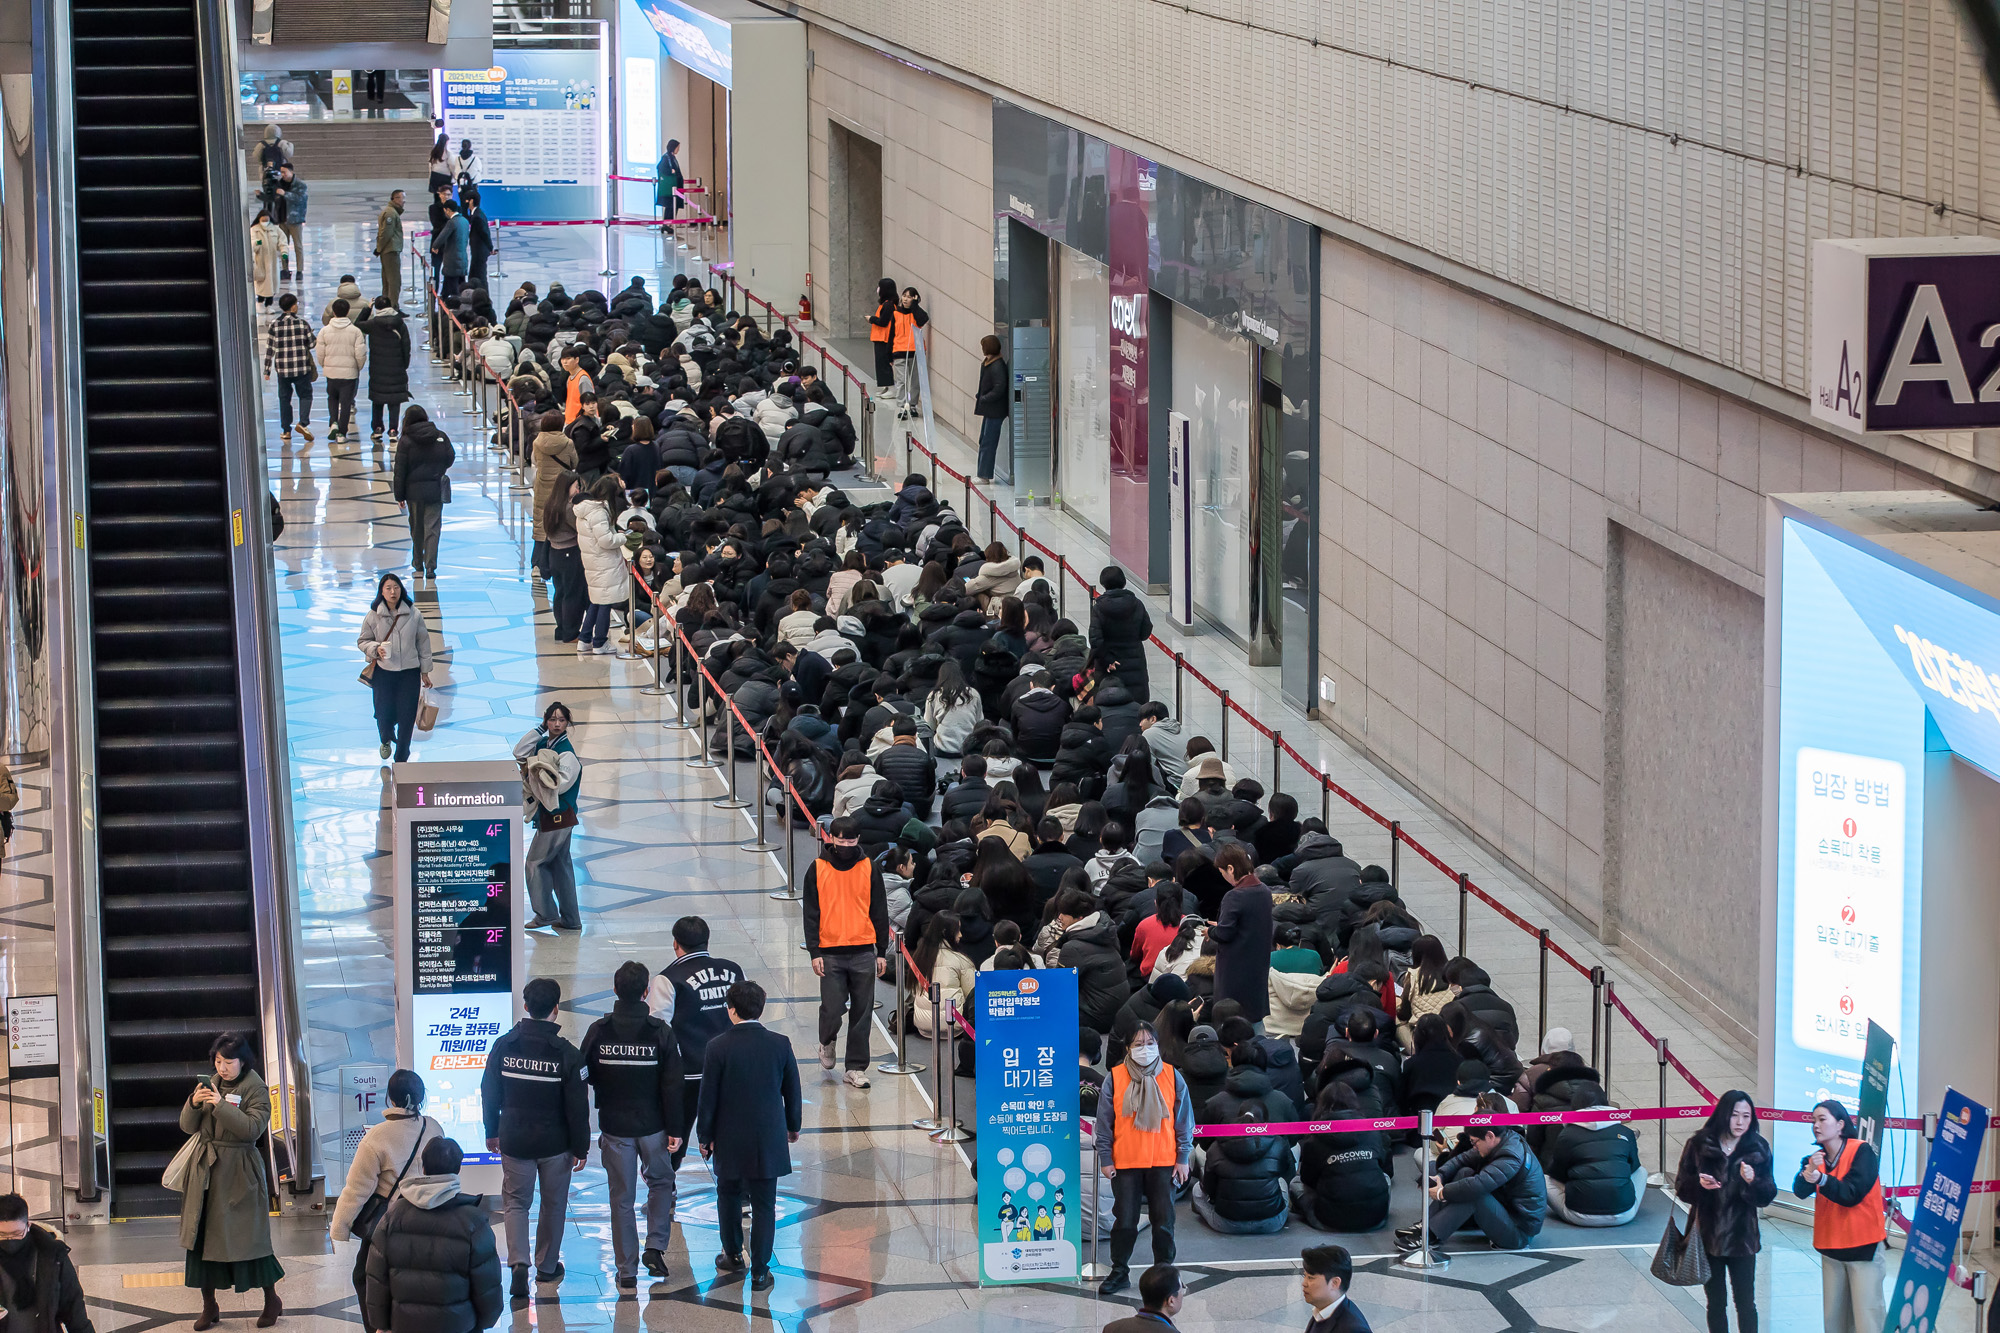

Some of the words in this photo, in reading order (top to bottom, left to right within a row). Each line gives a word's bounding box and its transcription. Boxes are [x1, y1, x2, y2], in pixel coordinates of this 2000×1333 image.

[1111, 294, 1137, 339] coex
[1819, 385, 1834, 409] Hall
[1835, 340, 1861, 420] A2
[1812, 770, 1847, 800] 입장
[1854, 778, 1889, 808] 방법
[434, 792, 504, 806] information
[486, 824, 503, 837] 4F
[1818, 838, 1853, 858] 손목띠
[1858, 844, 1881, 864] 착용
[486, 884, 504, 897] 3F
[1842, 906, 1855, 925] 2
[486, 930, 504, 943] 2F
[1817, 925, 1840, 945] 입장
[1844, 930, 1879, 953] 대기줄
[686, 968, 736, 991] EULJI
[988, 997, 1040, 1008] 대학입학정보
[1841, 996, 1854, 1015] 3
[988, 1007, 1015, 1017] 박람회
[426, 1024, 463, 1036] 고성능
[465, 1022, 500, 1036] 컴퓨팅
[1815, 1015, 1850, 1037] 전시장
[440, 1039, 487, 1052] 지원사업
[599, 1044, 656, 1057] SECURITY
[503, 1056, 560, 1073] SECURITY
[354, 1076, 376, 1084] South
[1004, 1068, 1054, 1088] 대기줄
[354, 1093, 376, 1112] 1F
[1000, 1101, 1026, 1111] 손목띠
[1028, 1100, 1044, 1111] 확인
[1047, 1099, 1055, 1109] 후
[988, 1114, 1013, 1124] 손등에
[1016, 1113, 1041, 1123] 확인용
[1043, 1112, 1068, 1122] 도장을
[1540, 1113, 1563, 1123] coex
[1609, 1110, 1632, 1120] coex
[1679, 1107, 1702, 1117] coex
[1373, 1118, 1396, 1128] coex
[1469, 1115, 1492, 1125] coex
[1002, 1124, 1054, 1136] 찍어드립니다.
[1245, 1124, 1268, 1134] coex
[1309, 1122, 1332, 1132] coex
